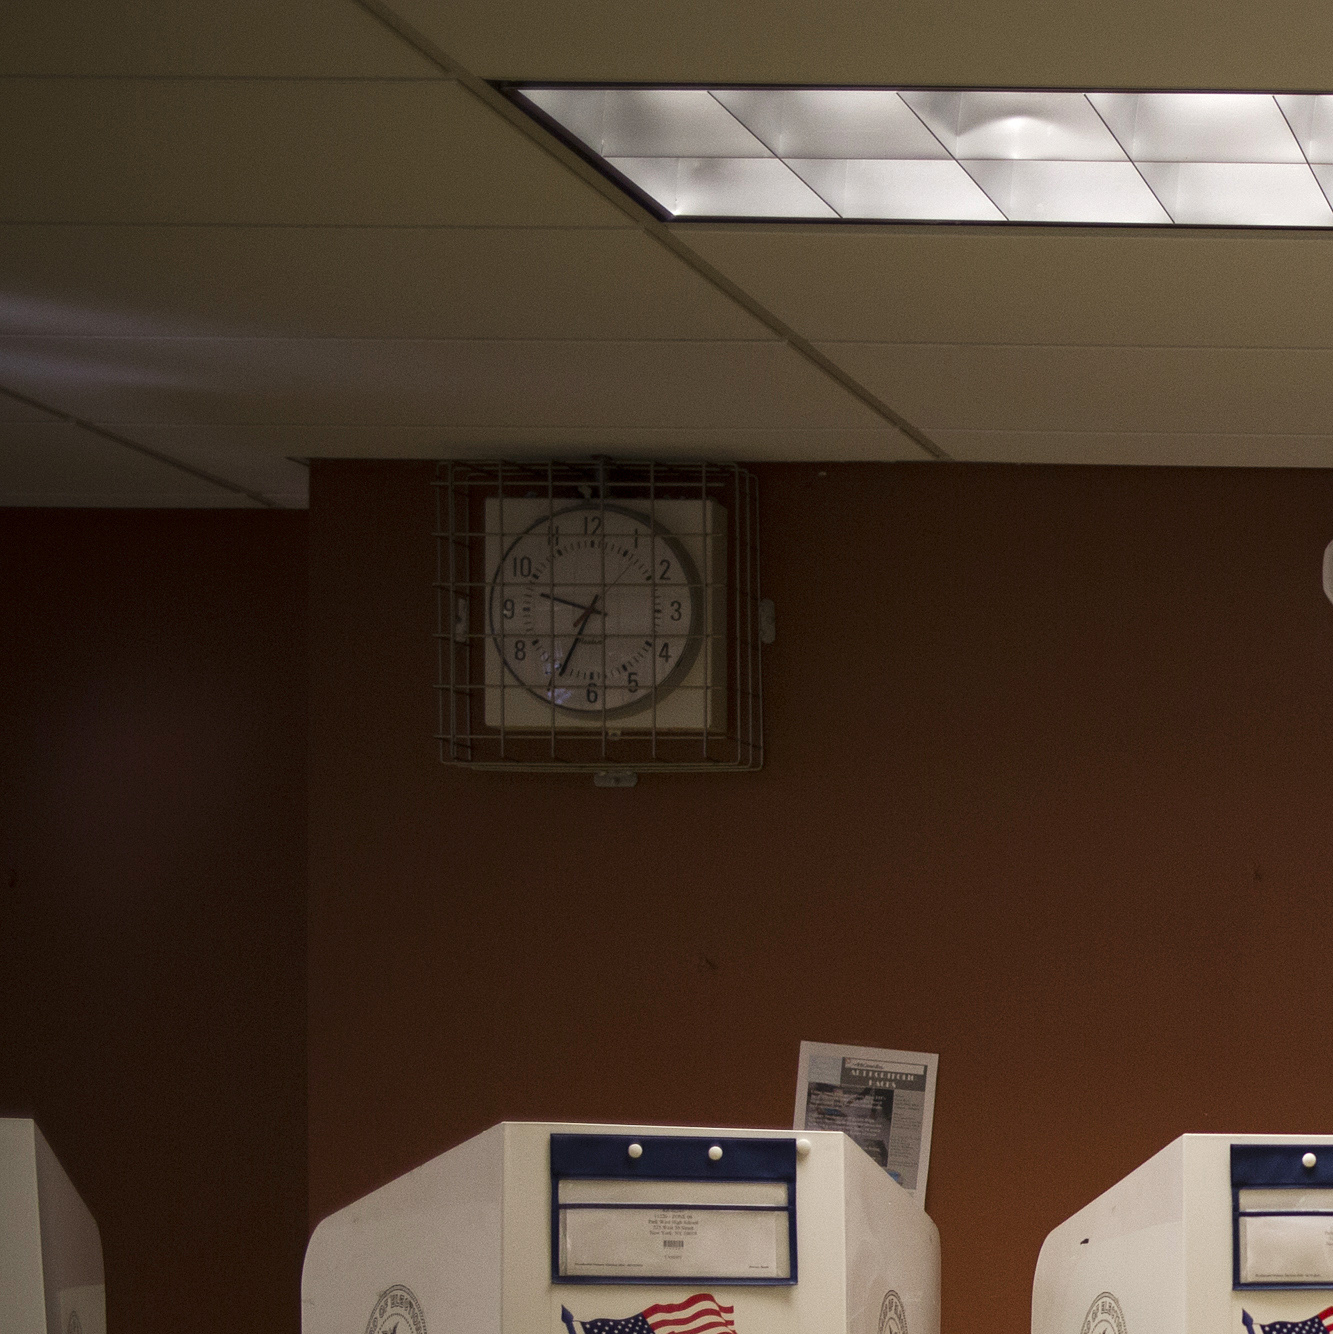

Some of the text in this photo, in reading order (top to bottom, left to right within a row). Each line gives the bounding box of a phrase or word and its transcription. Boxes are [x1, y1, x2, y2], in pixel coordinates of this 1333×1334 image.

[583, 516, 601, 536] 12
[512, 556, 532, 578] 10
[659, 559, 672, 581] 2
[502, 599, 515, 620] 9
[669, 601, 682, 622] 3
[514, 640, 526, 661] 8
[658, 642, 672, 663] 4
[586, 682, 599, 704] 6
[627, 672, 639, 694] 5
